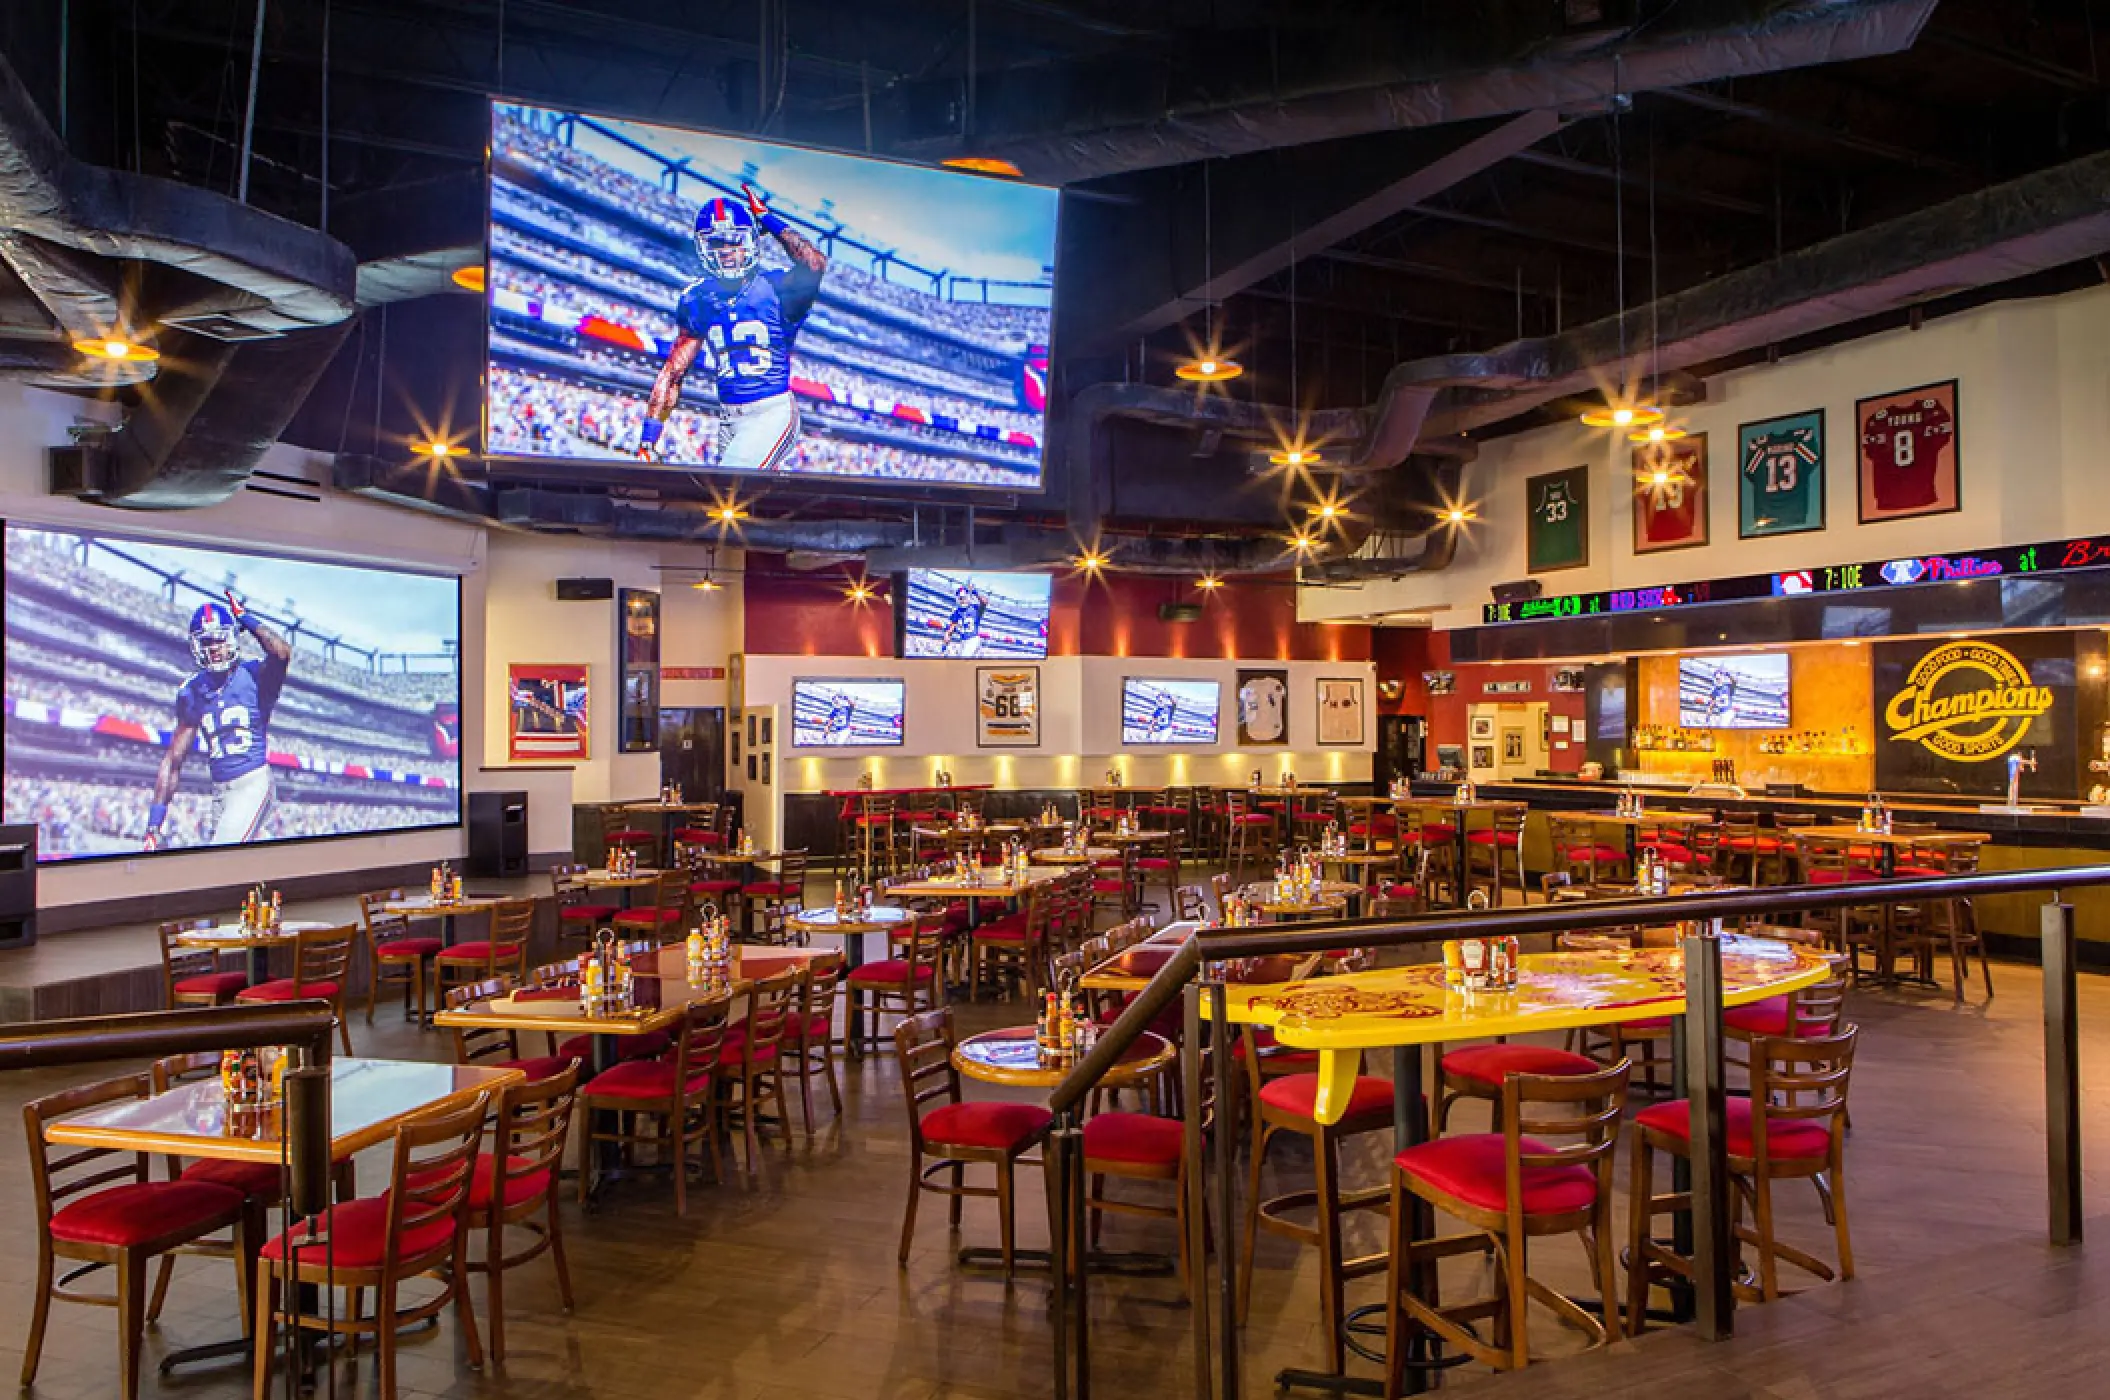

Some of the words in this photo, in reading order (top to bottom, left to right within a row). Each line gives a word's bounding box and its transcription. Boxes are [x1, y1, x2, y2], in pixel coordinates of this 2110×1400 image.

[707, 319, 772, 378] 13
[1894, 430, 1914, 467] 8
[1765, 455, 1797, 493] 13
[1546, 500, 1567, 523] 33
[2018, 547, 2038, 572] at
[1886, 684, 2054, 733] Champions
[201, 705, 253, 759] 13
